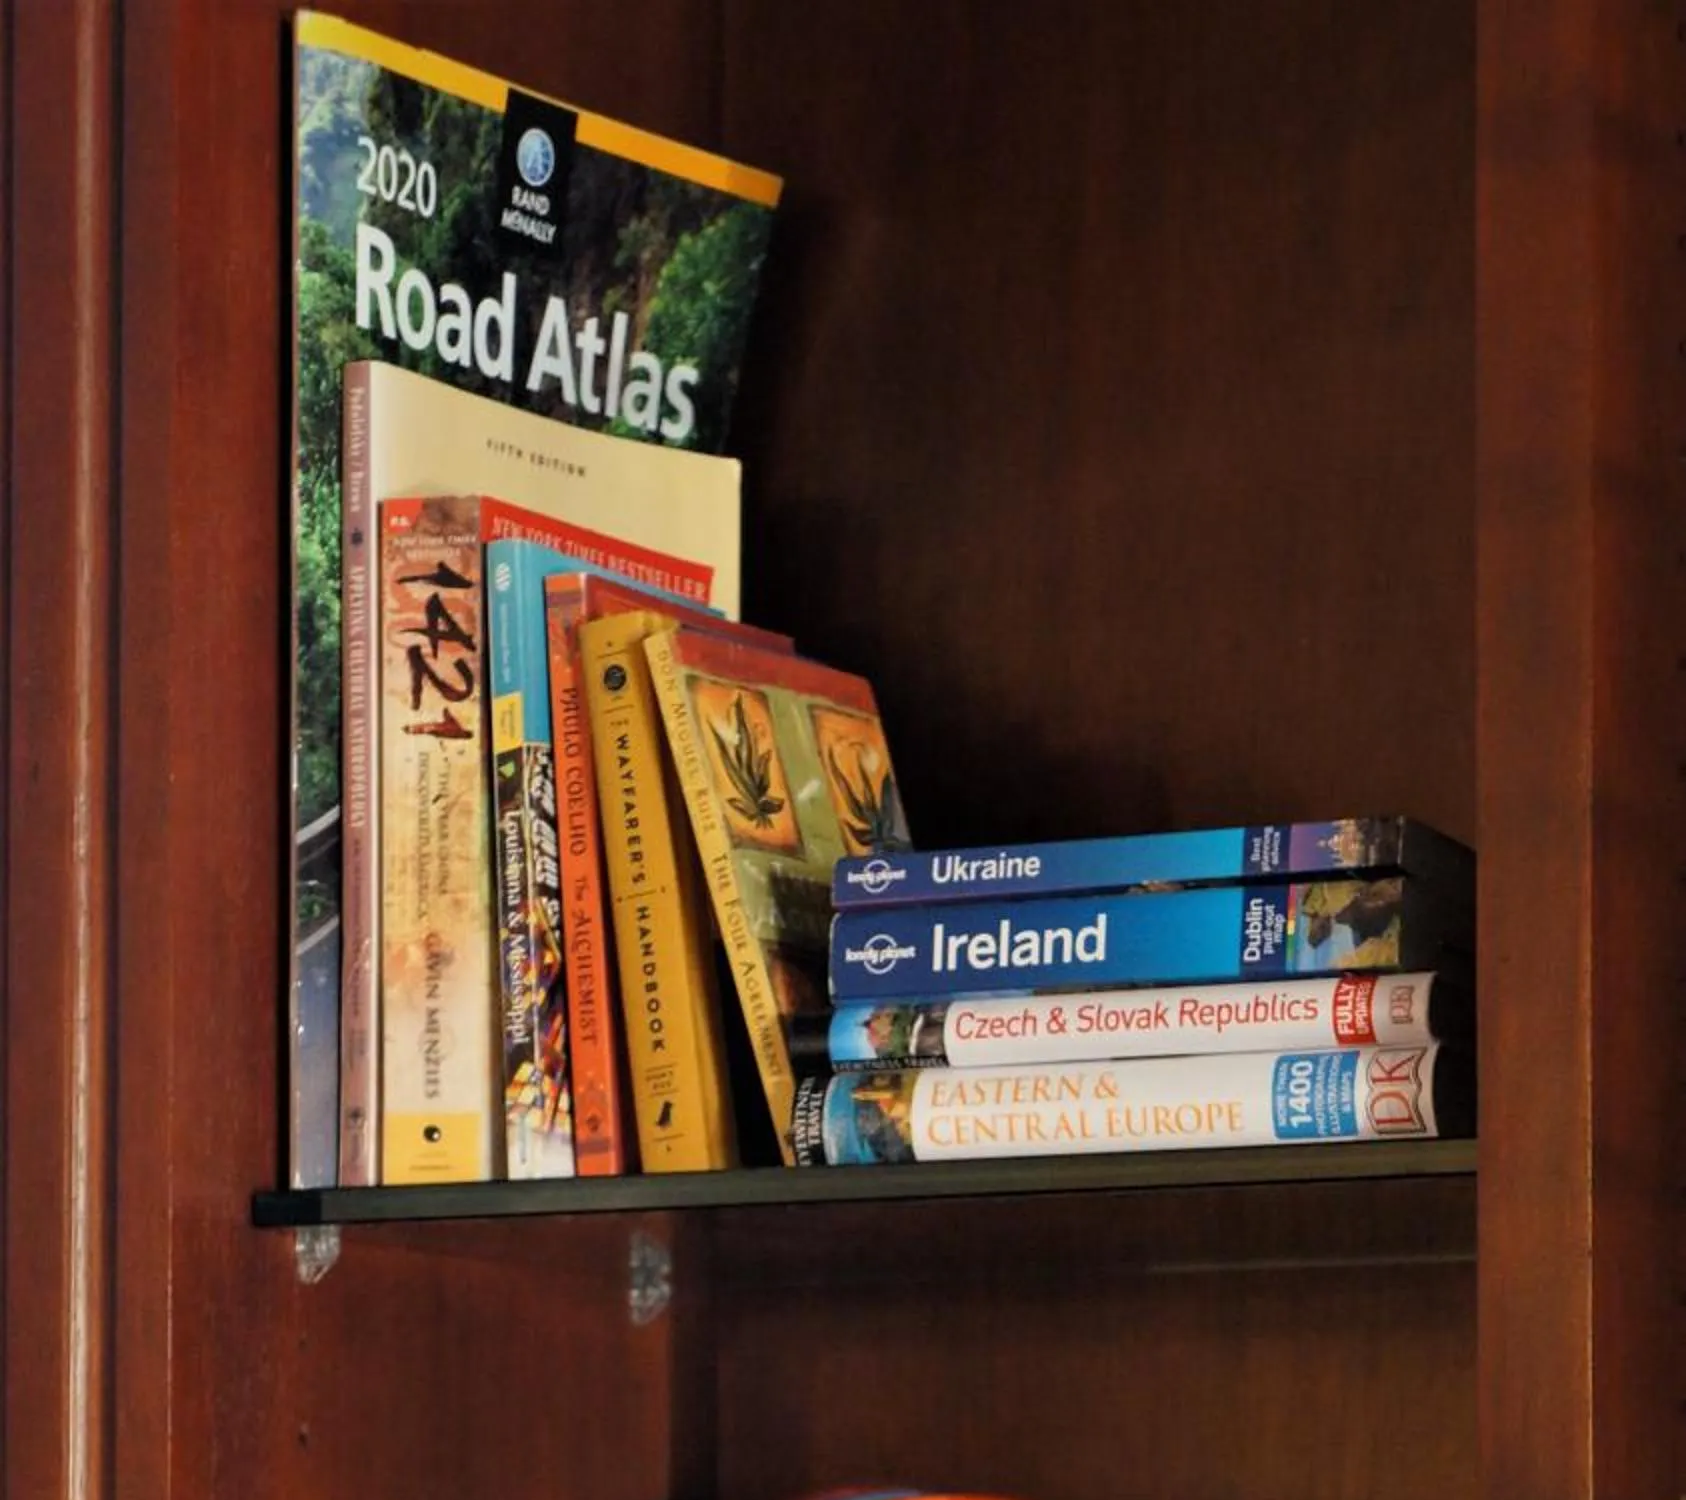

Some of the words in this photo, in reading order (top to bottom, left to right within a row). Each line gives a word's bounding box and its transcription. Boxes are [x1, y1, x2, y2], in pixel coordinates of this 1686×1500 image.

[356, 137, 437, 218] 2020
[511, 186, 550, 216] RAND
[356, 222, 517, 383] Road
[526, 296, 699, 441] Atlas
[486, 438, 523, 459] FIFTH
[530, 453, 586, 477] EDITION
[525, 527, 563, 552] YORK
[564, 540, 605, 564] TIMES
[606, 554, 707, 601] BESTSELLER
[349, 640, 367, 709] CULTURAL
[397, 561, 477, 739] 1421
[563, 687, 583, 758] PAULO
[349, 716, 367, 828] ANTHROPOLOGY
[565, 767, 588, 857] COELHO
[616, 733, 647, 884] WAYFARER'S
[504, 809, 524, 906] Louisiana
[932, 852, 1041, 884] Ukraine
[507, 911, 525, 928] &
[932, 914, 1107, 972] Ireland
[1243, 897, 1264, 963] Dublin
[424, 933, 442, 998] GAVIN
[506, 933, 530, 1045] Mississippi
[572, 910, 598, 1046] ALCHEMIST
[636, 905, 665, 1053] HANDBOOK
[955, 1010, 1038, 1040] Czech
[1046, 1007, 1067, 1034] &
[1077, 998, 1170, 1033] Slovak
[1179, 993, 1319, 1034] Republics
[1336, 980, 1355, 1035] FULLY
[424, 1006, 442, 1100] MENZIES
[928, 1108, 1098, 1146] CENTRAL
[1106, 1101, 1243, 1138] EUROPE
[932, 1075, 1083, 1107] EASTERN
[1094, 1070, 1121, 1099] &
[1289, 1060, 1313, 1129] 1400
[1370, 1054, 1416, 1124] DK
